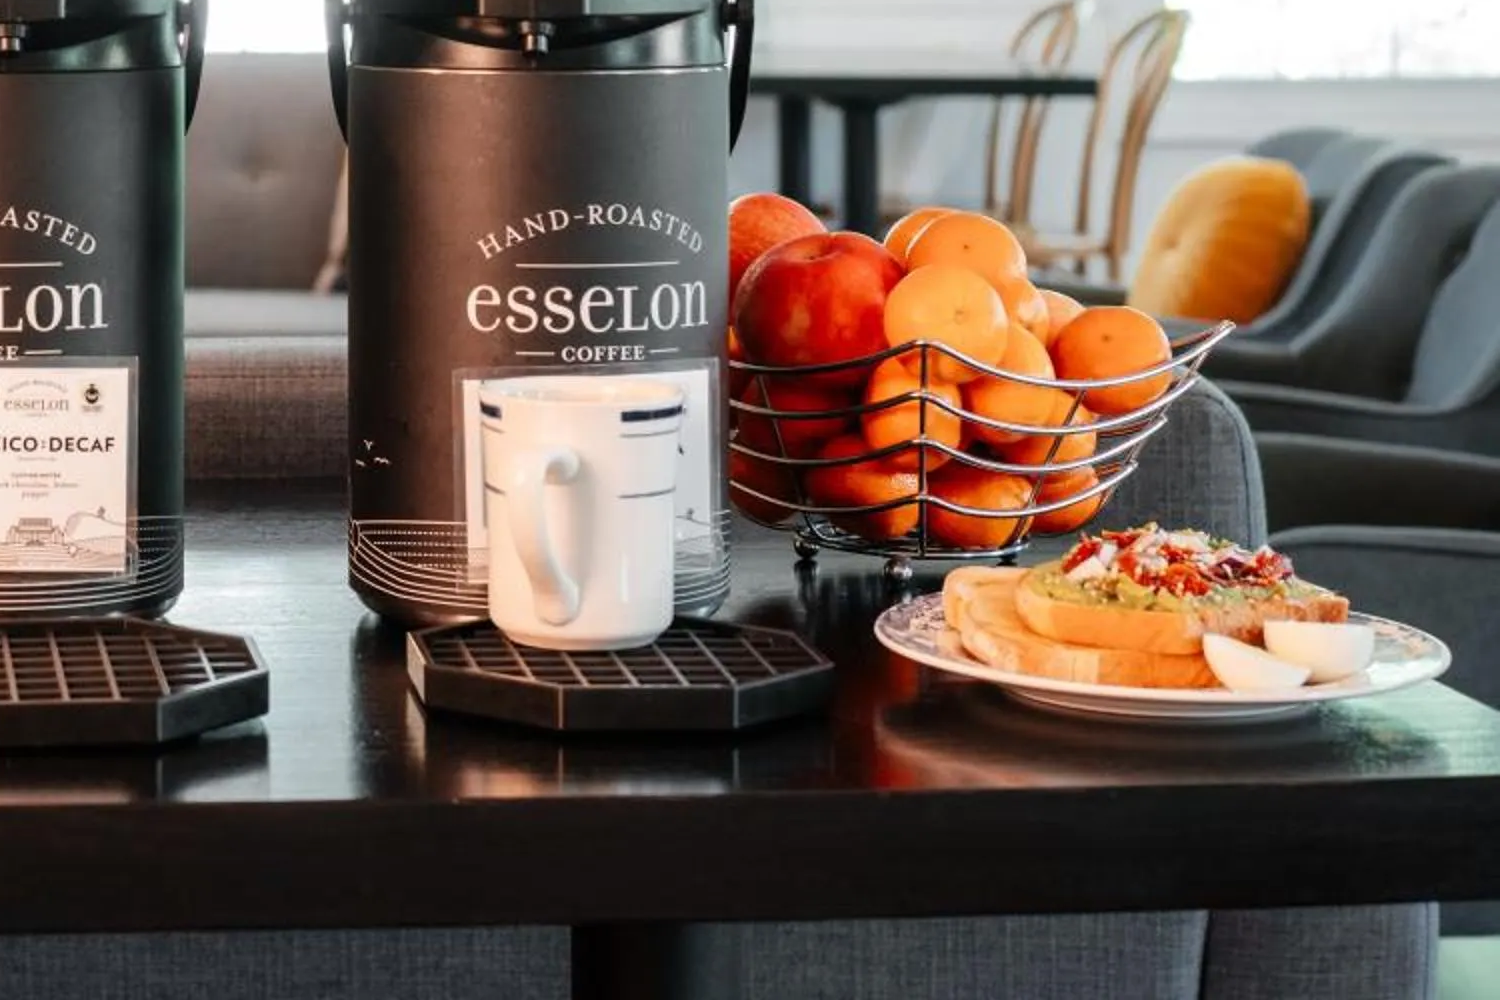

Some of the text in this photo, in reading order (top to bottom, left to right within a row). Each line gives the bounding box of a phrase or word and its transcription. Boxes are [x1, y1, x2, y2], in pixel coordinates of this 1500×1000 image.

[476, 203, 703, 260] HAND-ROASTED
[560, 345, 645, 362] COFFEE
[48, 436, 115, 453] DECAF
